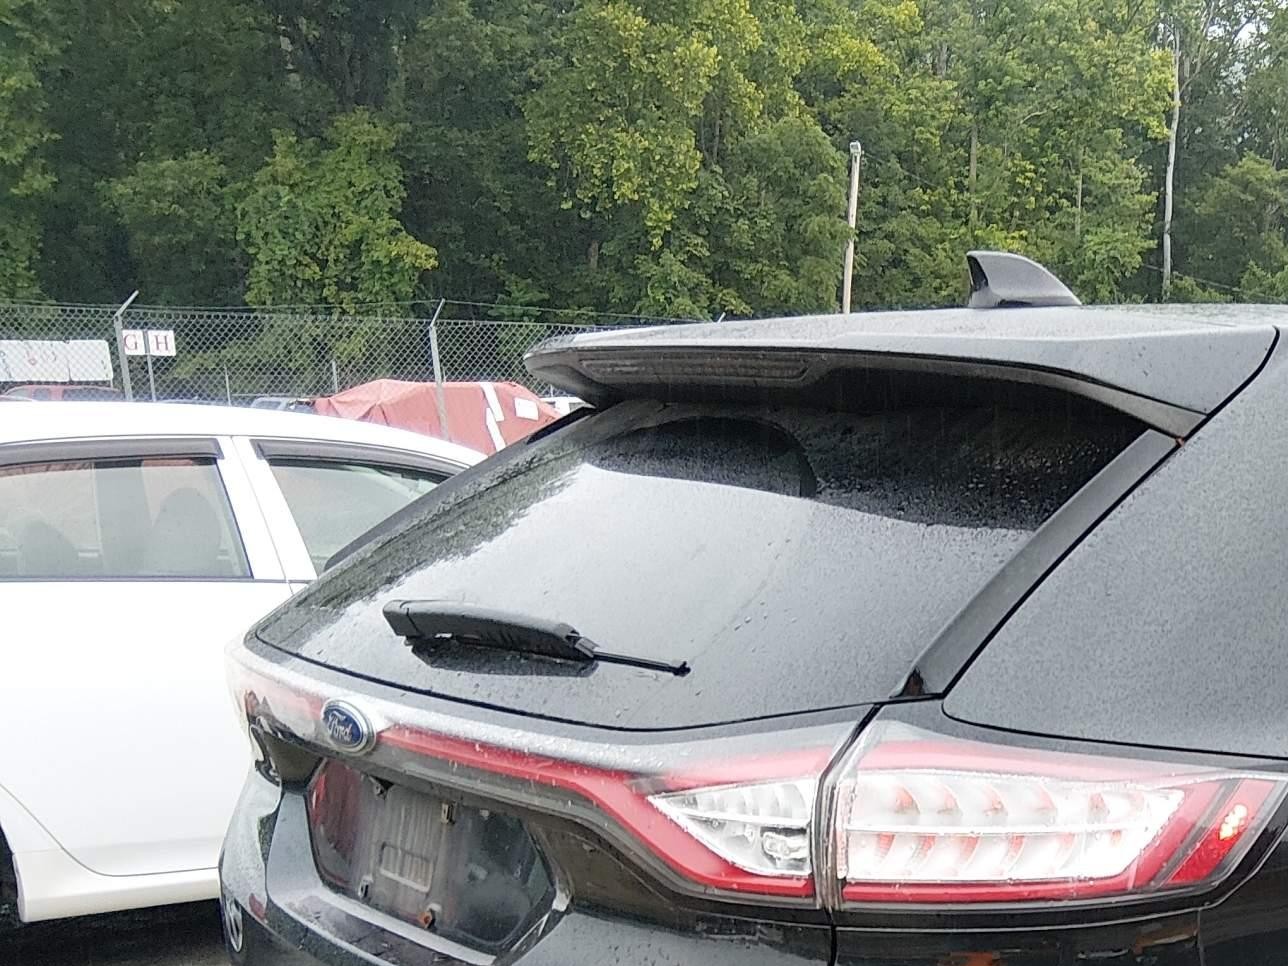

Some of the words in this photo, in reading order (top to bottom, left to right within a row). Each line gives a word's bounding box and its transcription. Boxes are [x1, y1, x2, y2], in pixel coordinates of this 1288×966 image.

[123, 334, 138, 350] G
[154, 335, 169, 351] H
[327, 710, 354, 742] Ford
